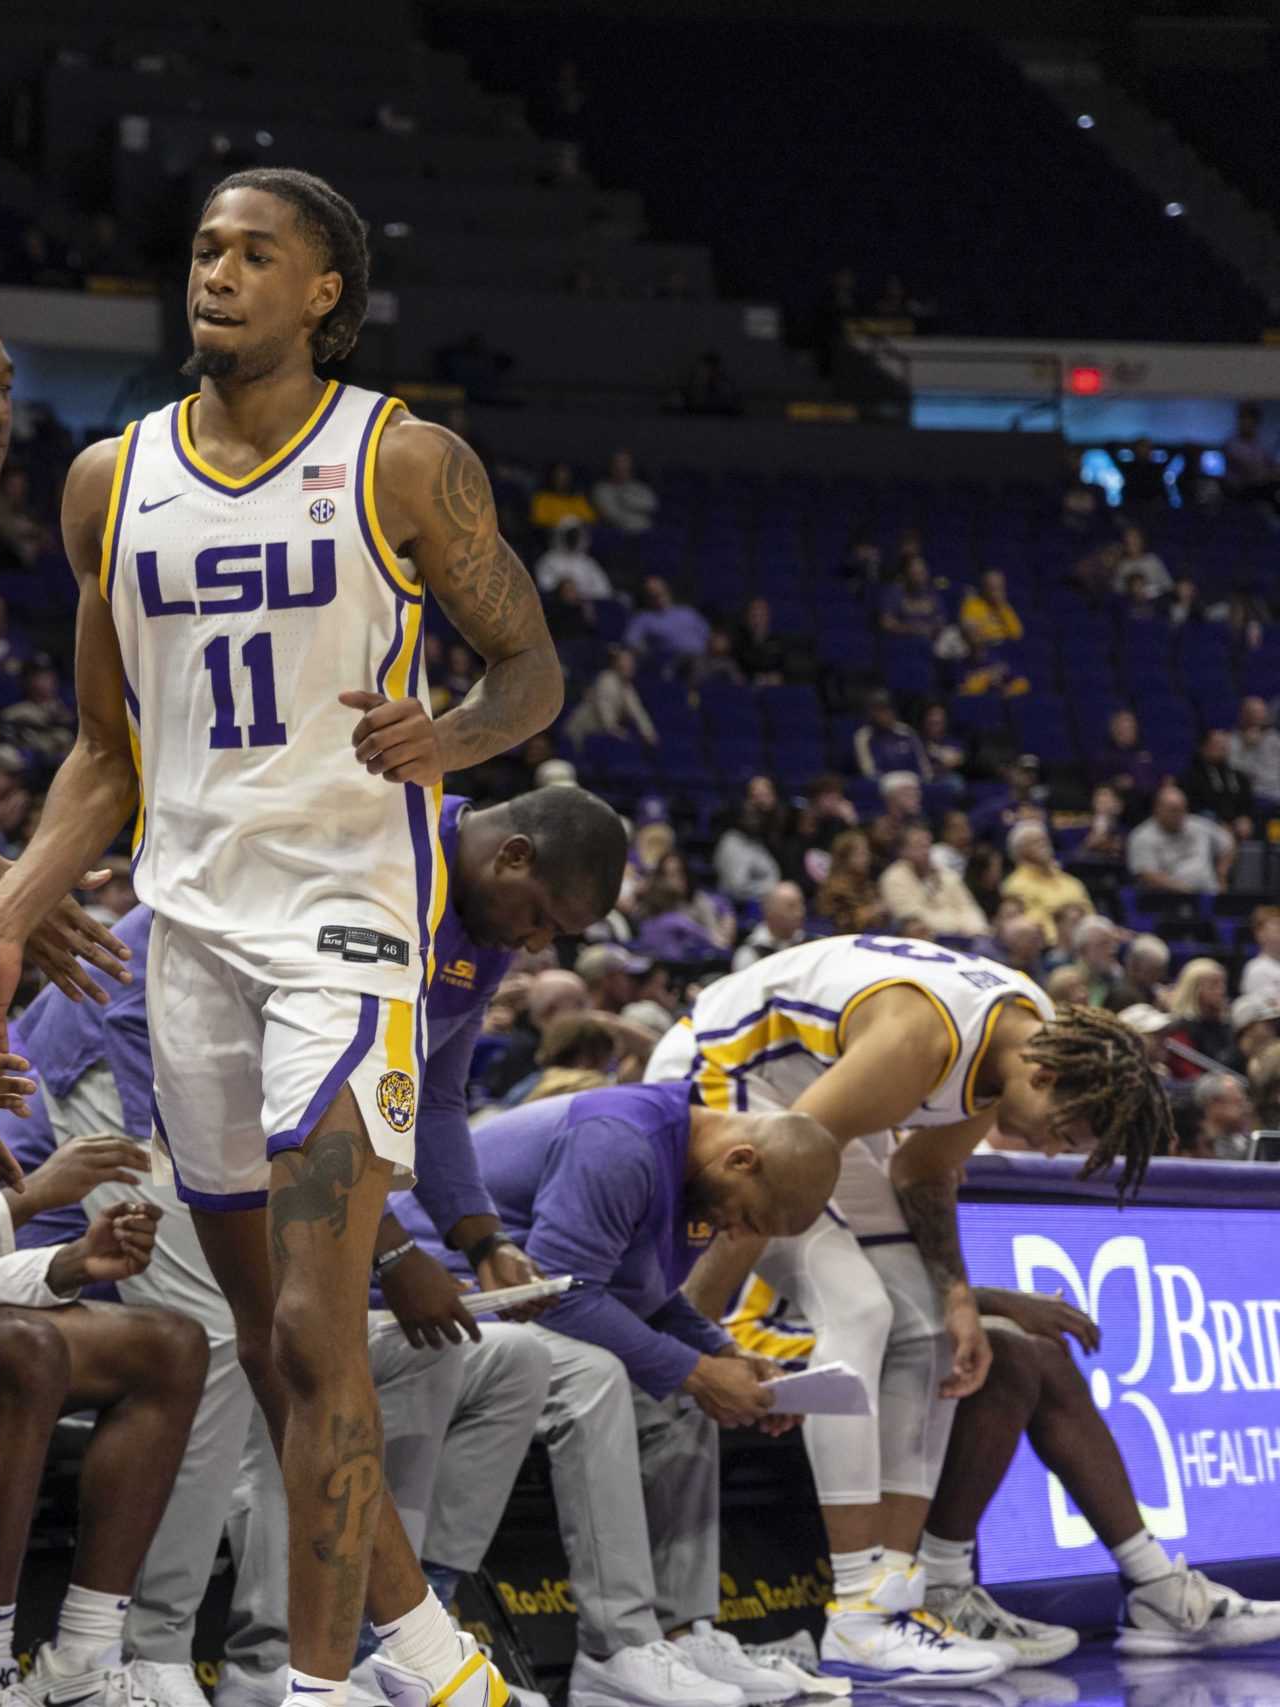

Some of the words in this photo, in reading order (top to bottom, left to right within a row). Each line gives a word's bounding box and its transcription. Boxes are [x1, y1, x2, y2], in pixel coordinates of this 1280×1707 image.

[311, 499, 334, 522] SEC
[136, 539, 337, 617] LSU
[204, 632, 287, 749] 11
[383, 943, 398, 956] 46
[1179, 1427, 1280, 1487] HEALTH
